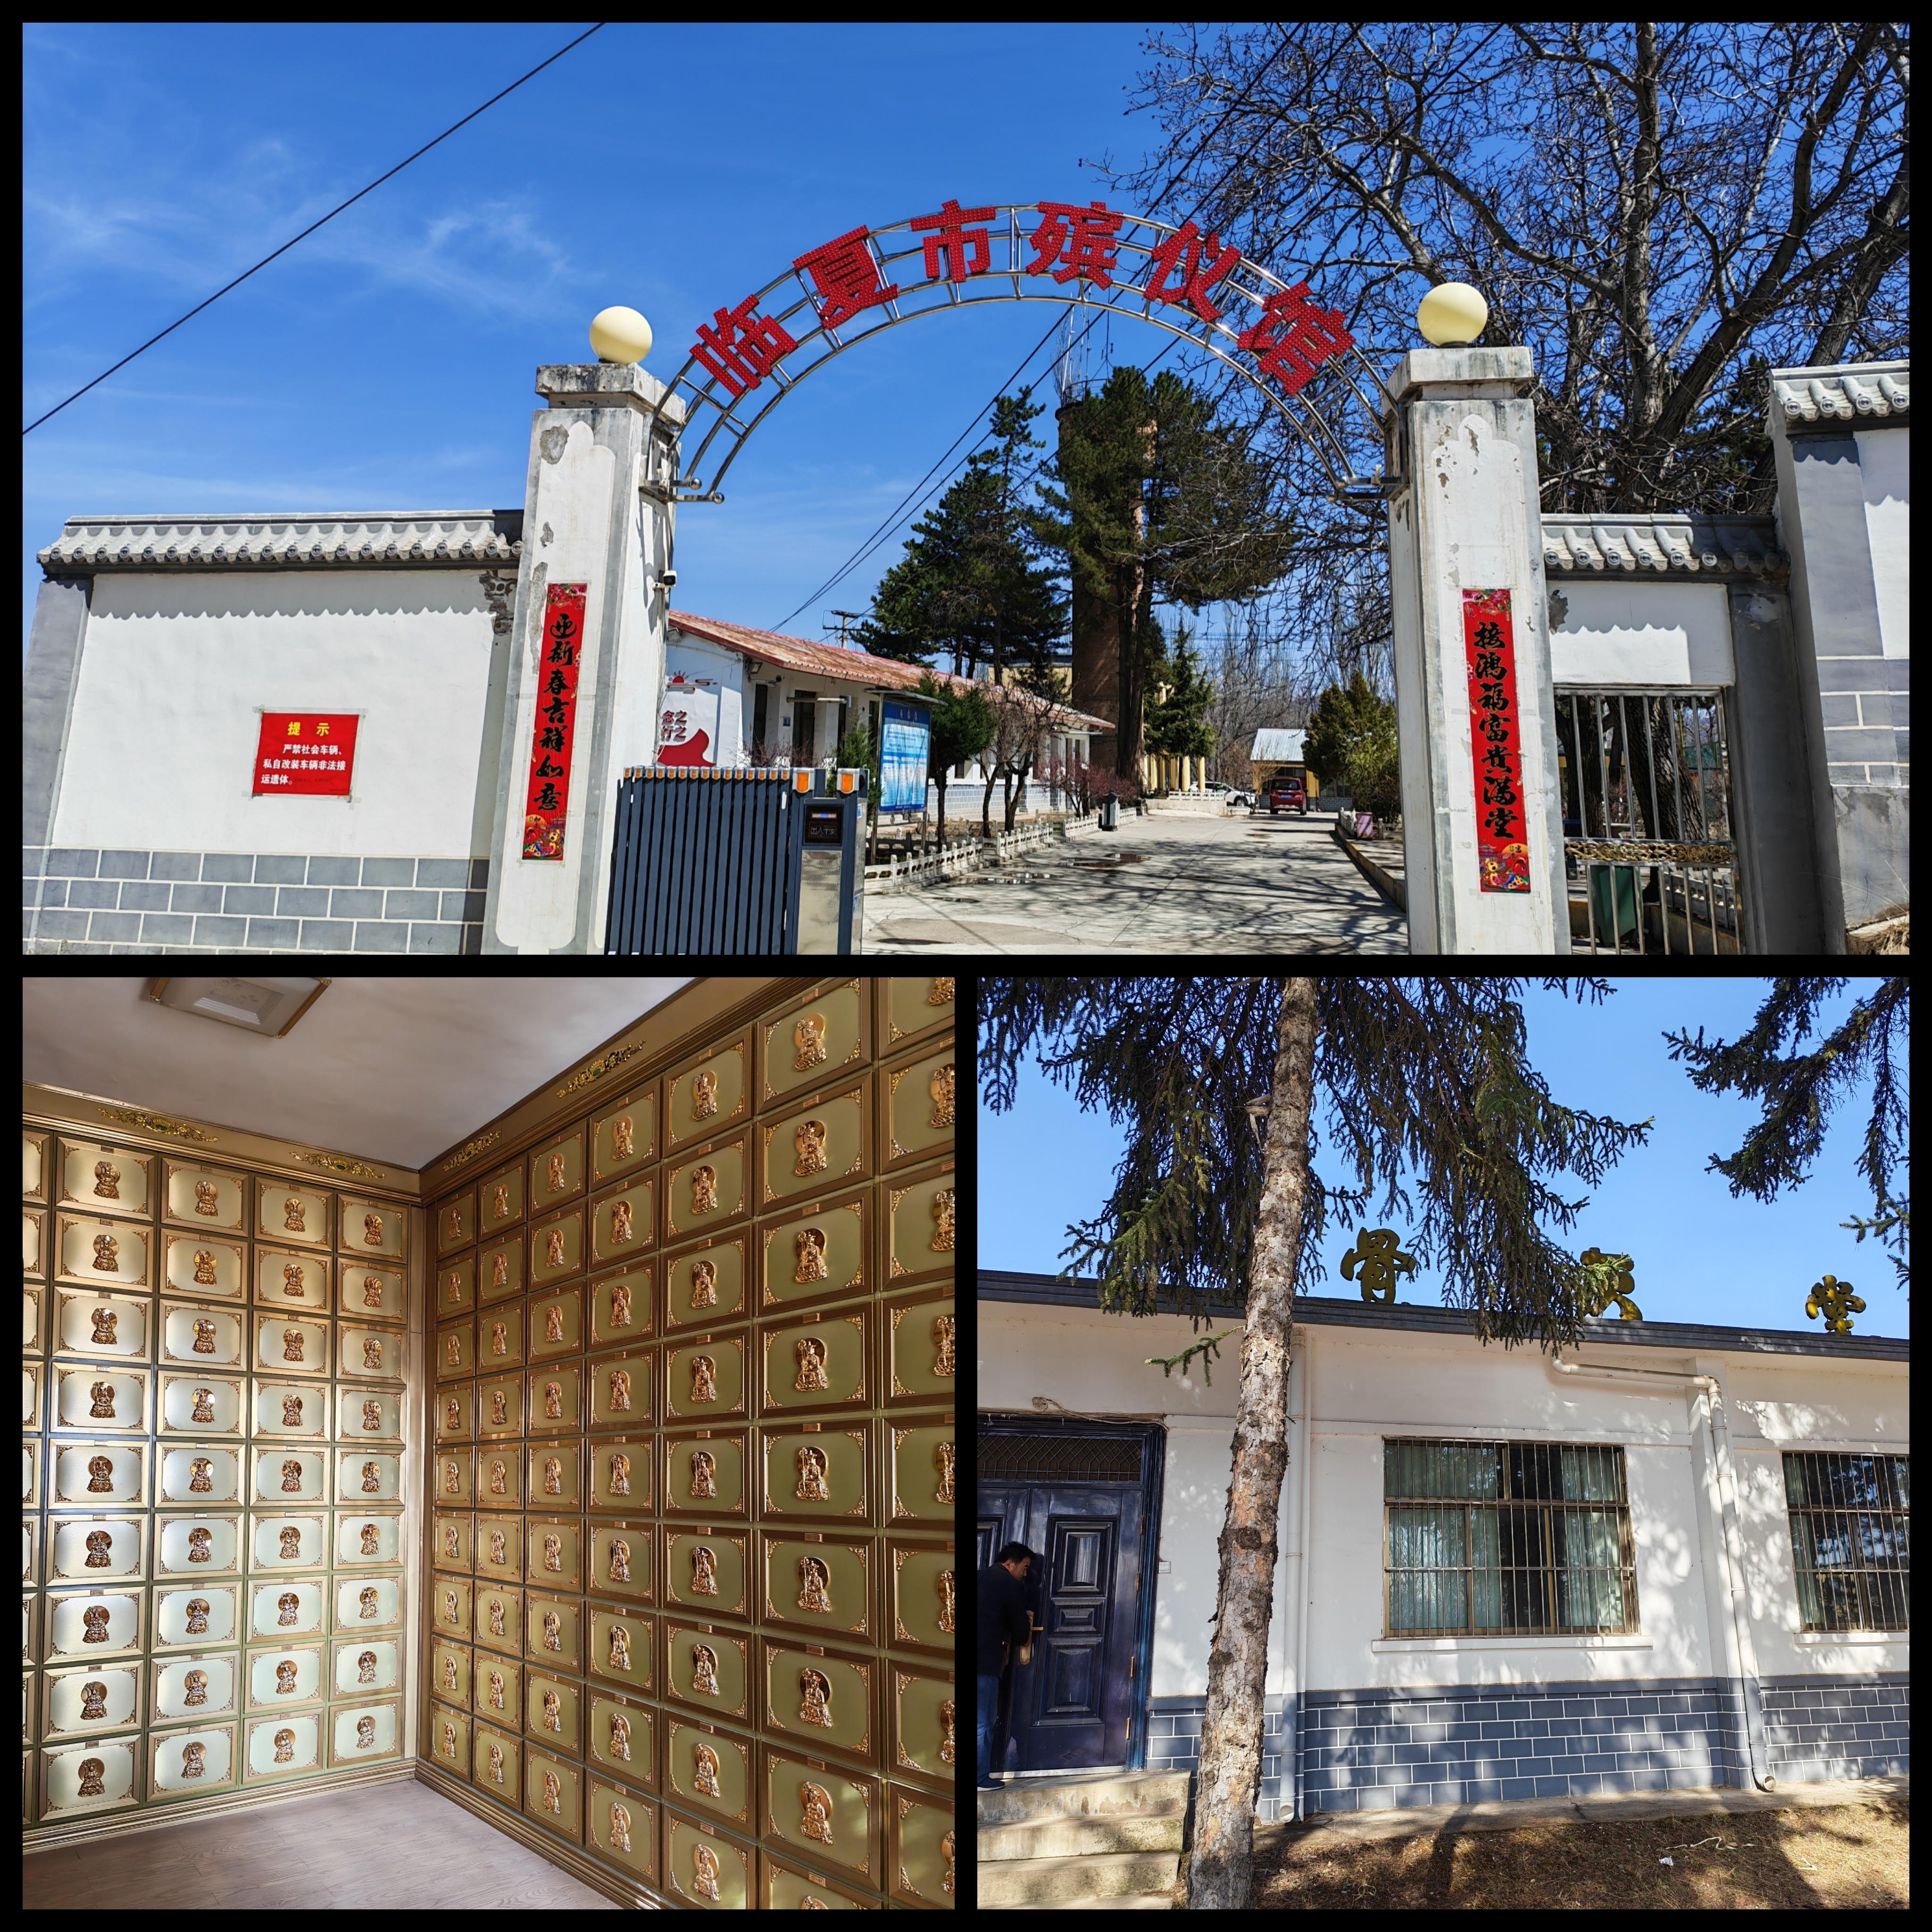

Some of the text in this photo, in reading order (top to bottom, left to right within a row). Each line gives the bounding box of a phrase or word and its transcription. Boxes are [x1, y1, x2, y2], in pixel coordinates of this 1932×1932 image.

[689, 200, 1356, 398] 临夏市殡仪馆
[533, 613, 577, 810] 迎新春吉祥如意
[287, 722, 330, 736] 提示
[263, 758, 346, 771] 私自改装车辆非法接
[811, 824, 836, 835] 出入平安
